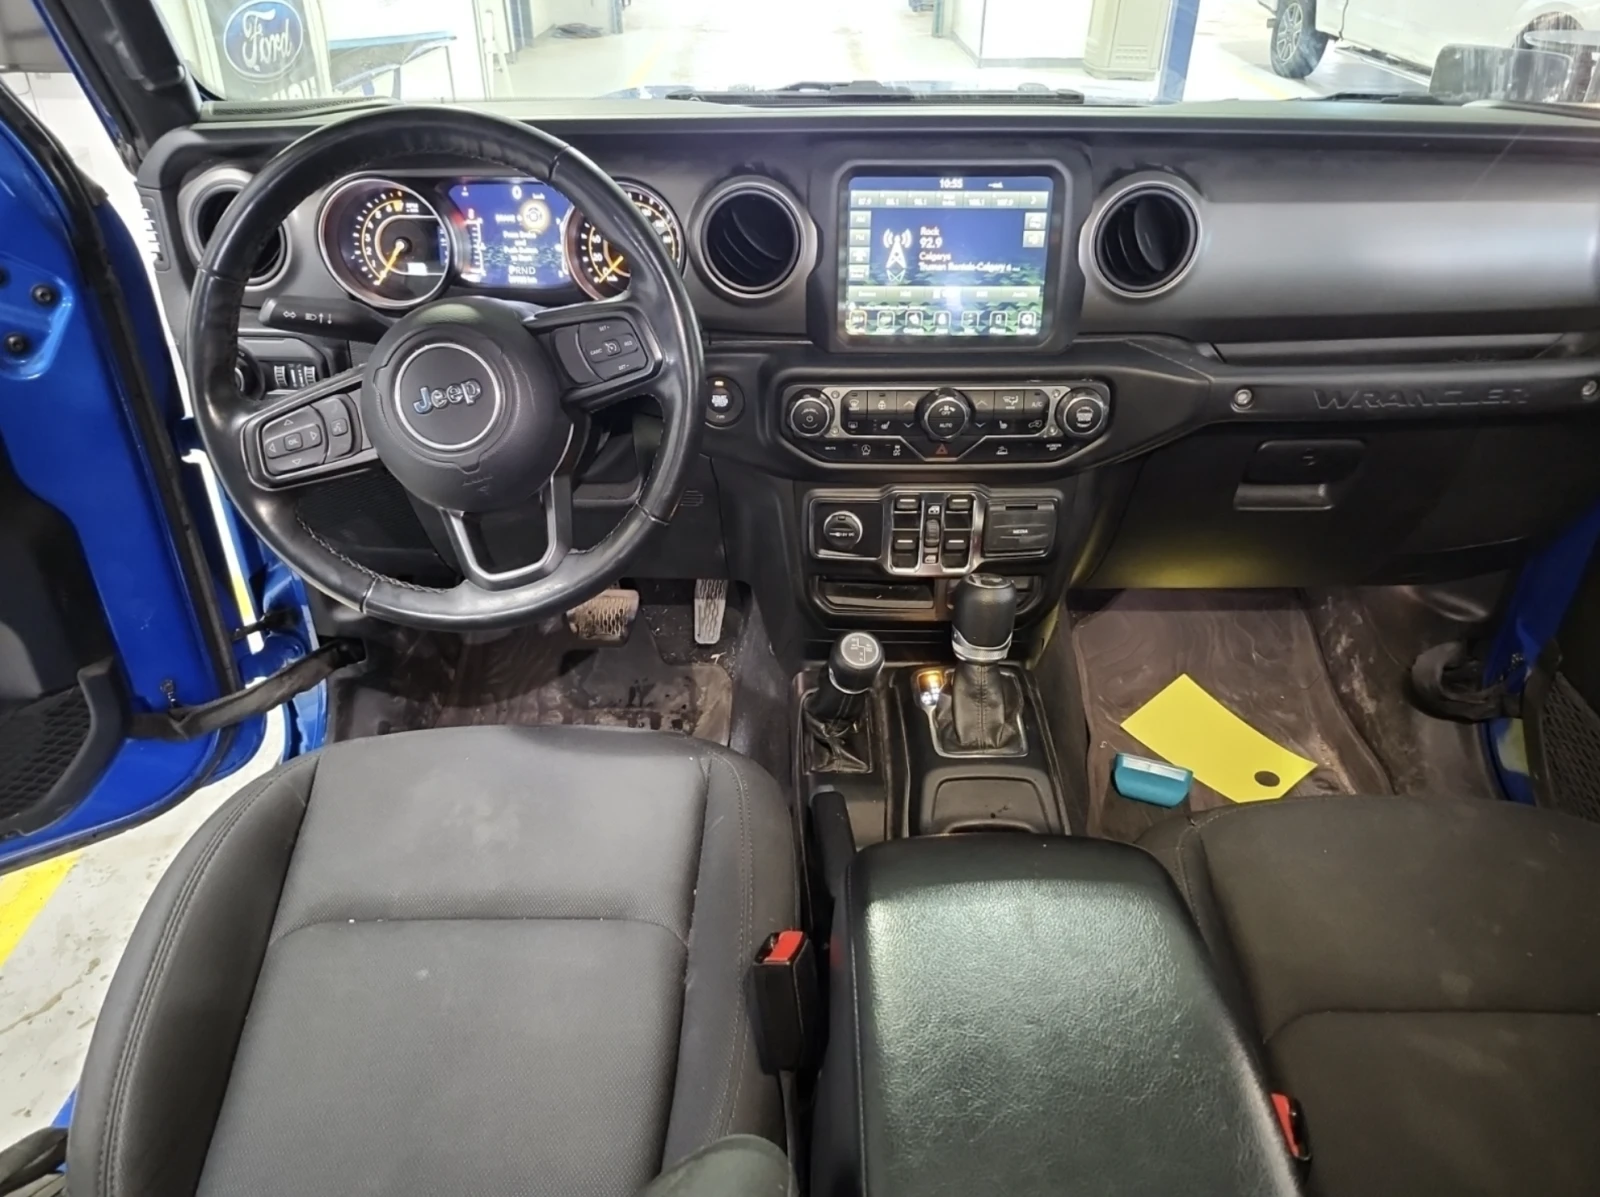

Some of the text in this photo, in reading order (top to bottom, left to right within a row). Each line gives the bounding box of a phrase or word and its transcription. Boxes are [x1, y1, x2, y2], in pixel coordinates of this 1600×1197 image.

[242, 8, 292, 72] Ford
[511, 185, 522, 200] 0
[919, 236, 943, 249] 92.9
[365, 246, 372, 256] 2
[413, 380, 482, 414] Jeep
